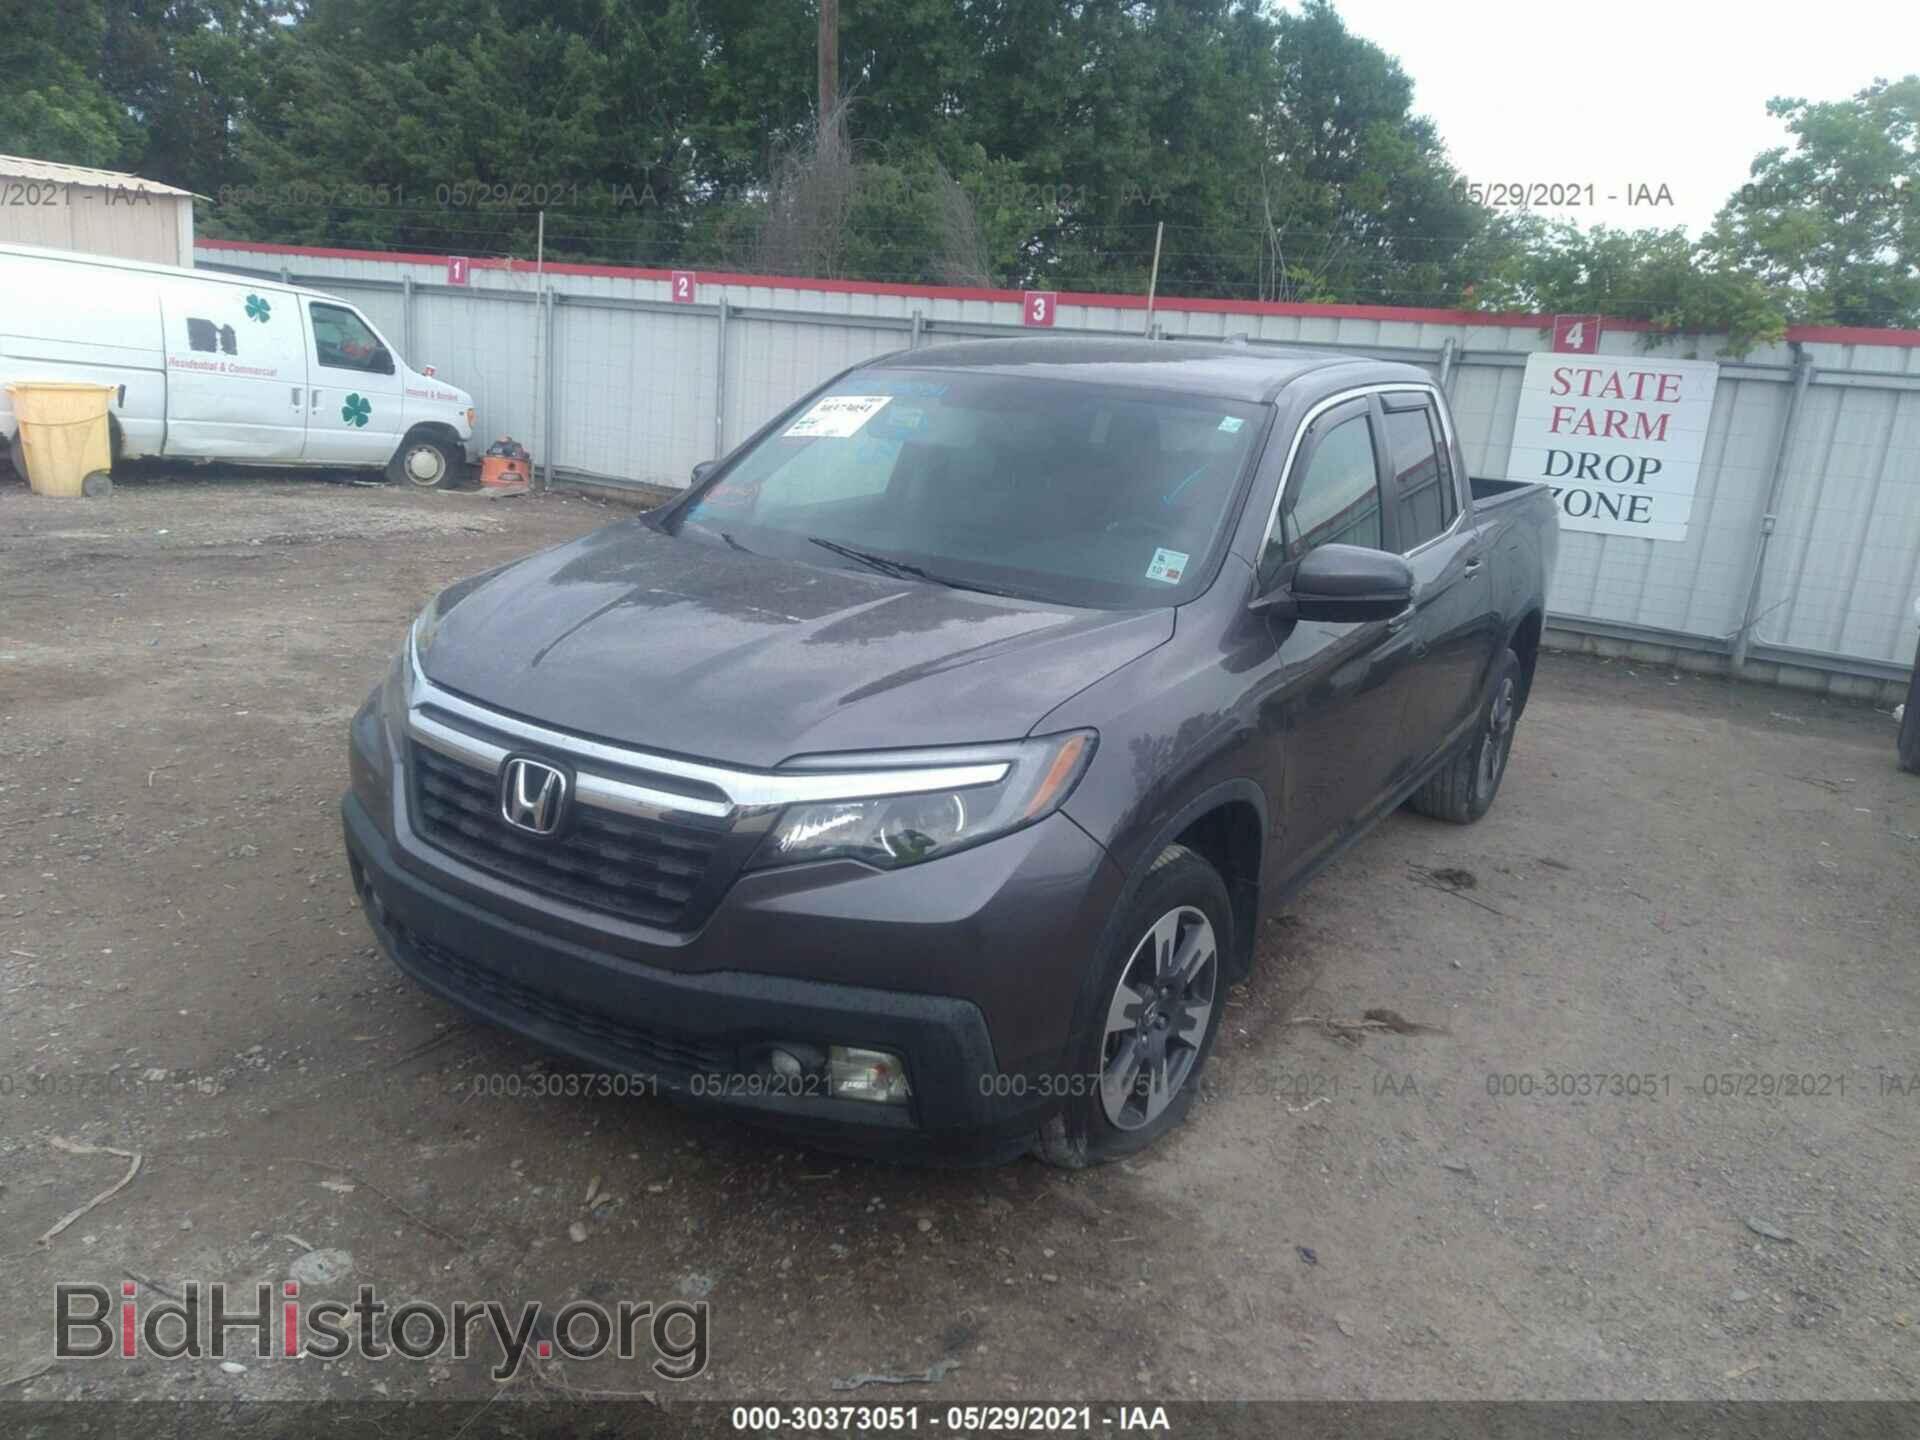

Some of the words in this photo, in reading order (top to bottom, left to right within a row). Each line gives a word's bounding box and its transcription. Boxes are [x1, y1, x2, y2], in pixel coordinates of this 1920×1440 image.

[453, 261, 463, 280] 1
[677, 278, 689, 297] 2
[1032, 298, 1046, 321] 3
[1565, 321, 1584, 349] 4
[1550, 366, 1683, 403] STATE
[1548, 405, 1672, 442] FARM
[1542, 449, 1661, 485] DROP
